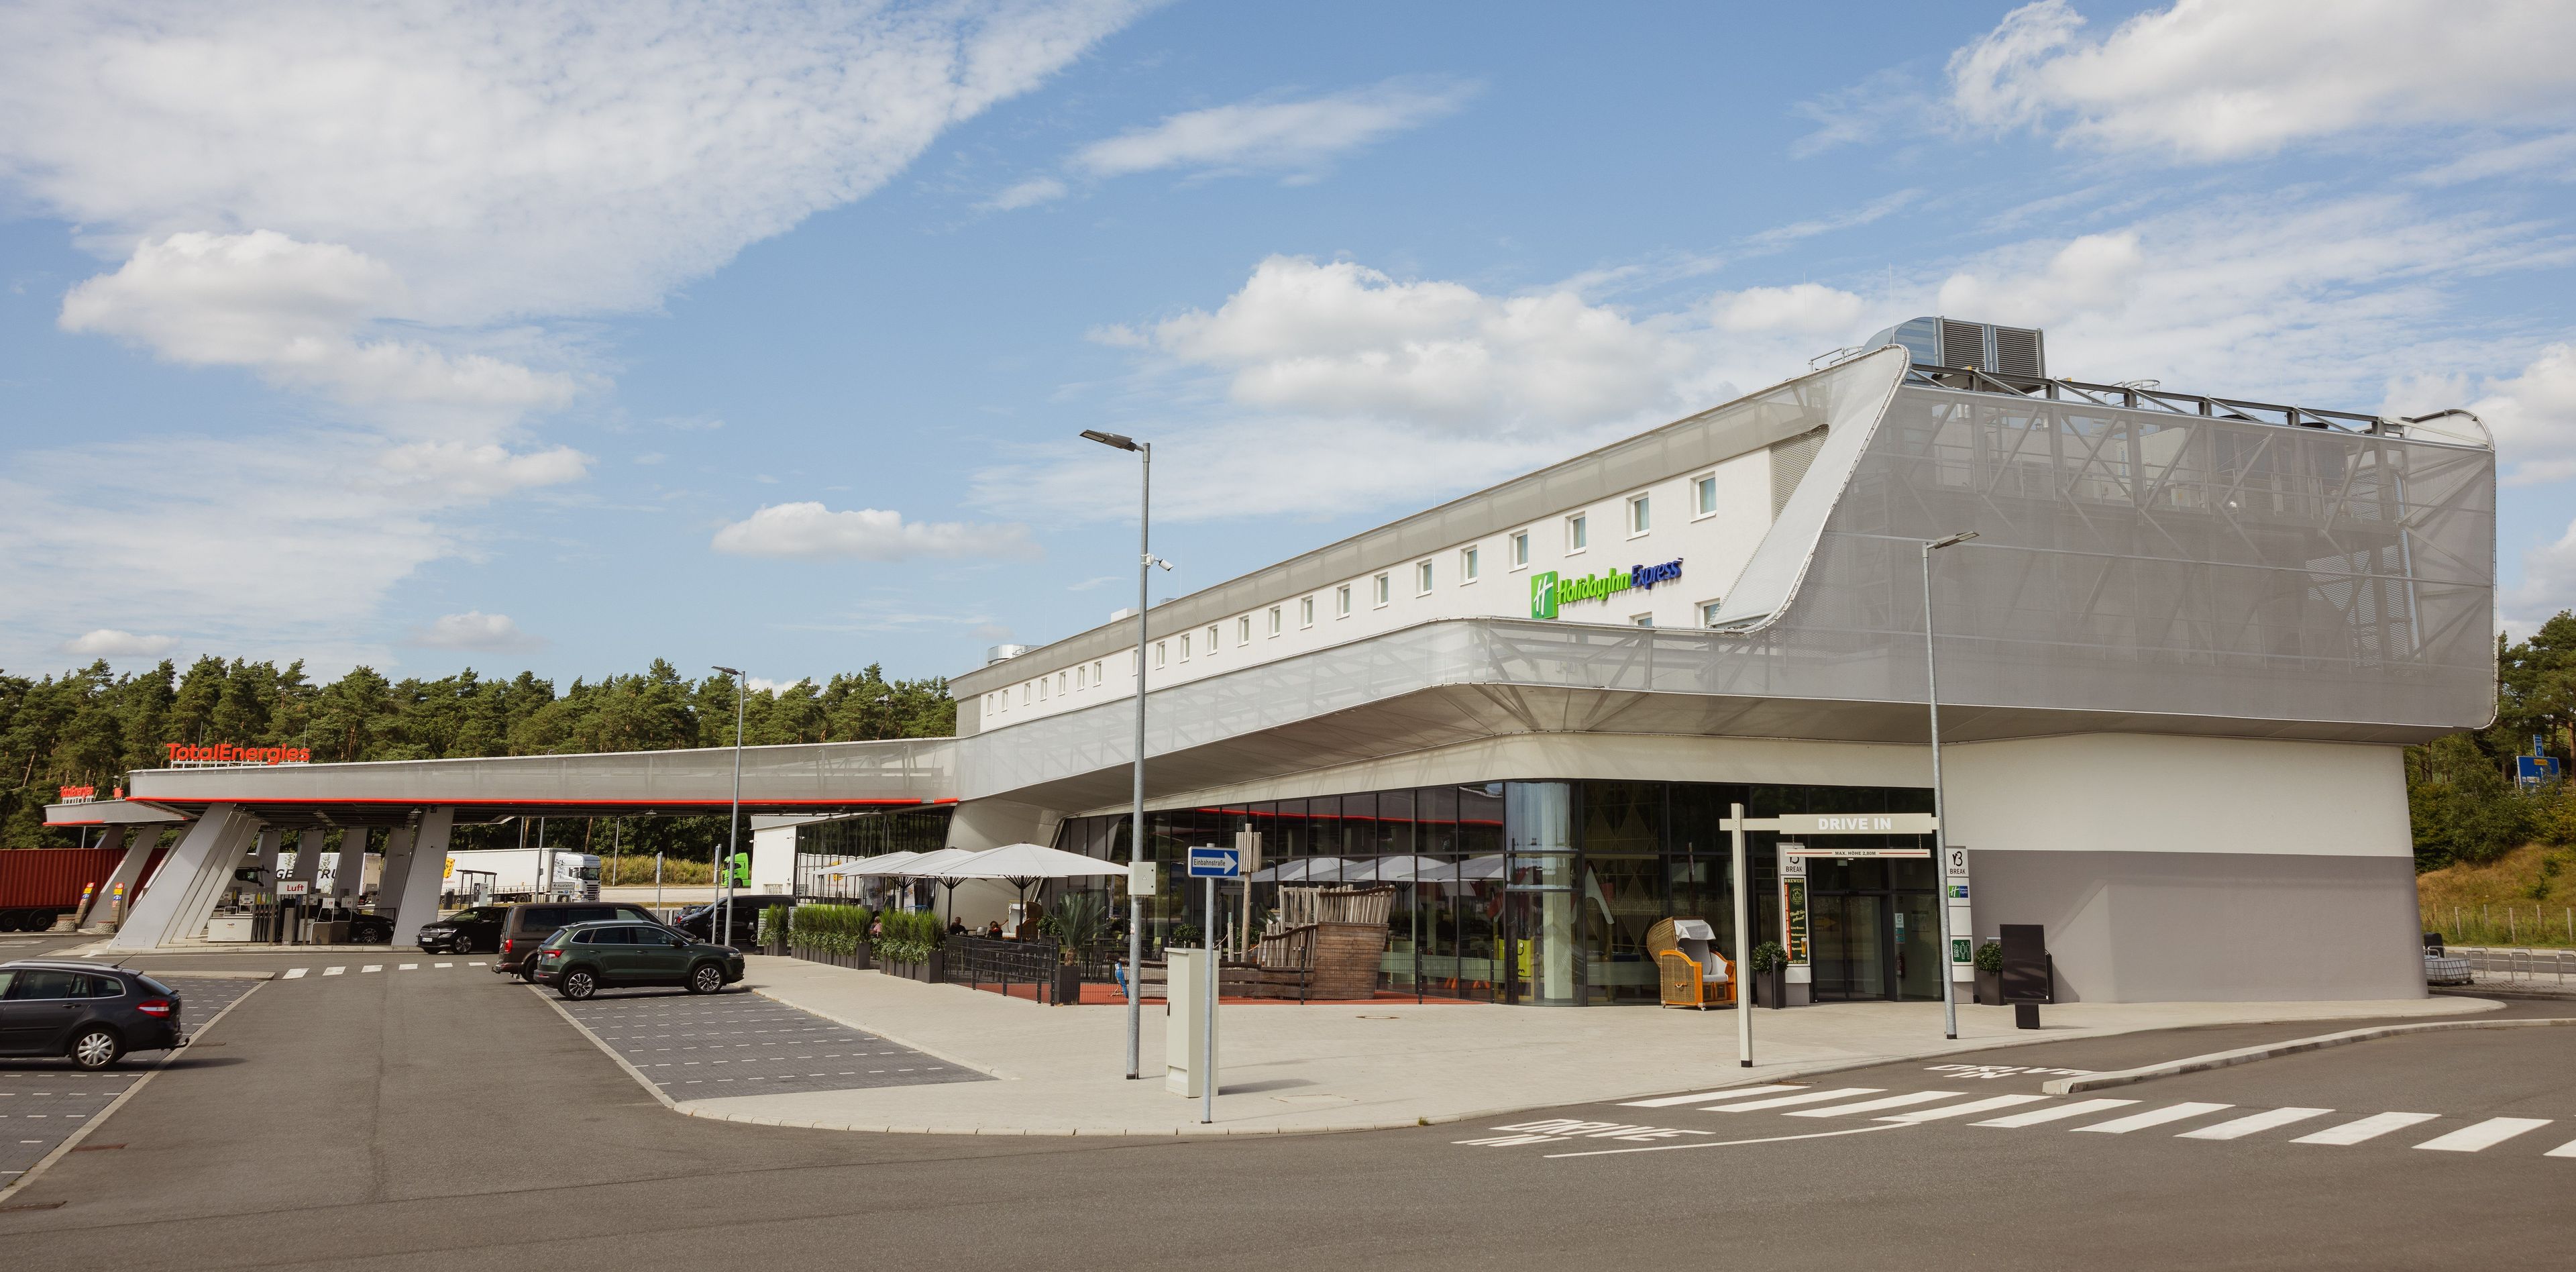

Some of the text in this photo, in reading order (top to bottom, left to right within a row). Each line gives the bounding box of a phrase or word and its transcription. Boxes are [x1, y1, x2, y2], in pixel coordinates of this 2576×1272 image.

[1631, 560, 1682, 590] Express
[166, 743, 311, 765] TotalEnergies
[60, 784, 94, 799] TotalEnergies
[1818, 817, 1892, 831] DRIVE IN
[1489, 1118, 1717, 1141] DRIVE
[1450, 1134, 1572, 1147] IN
